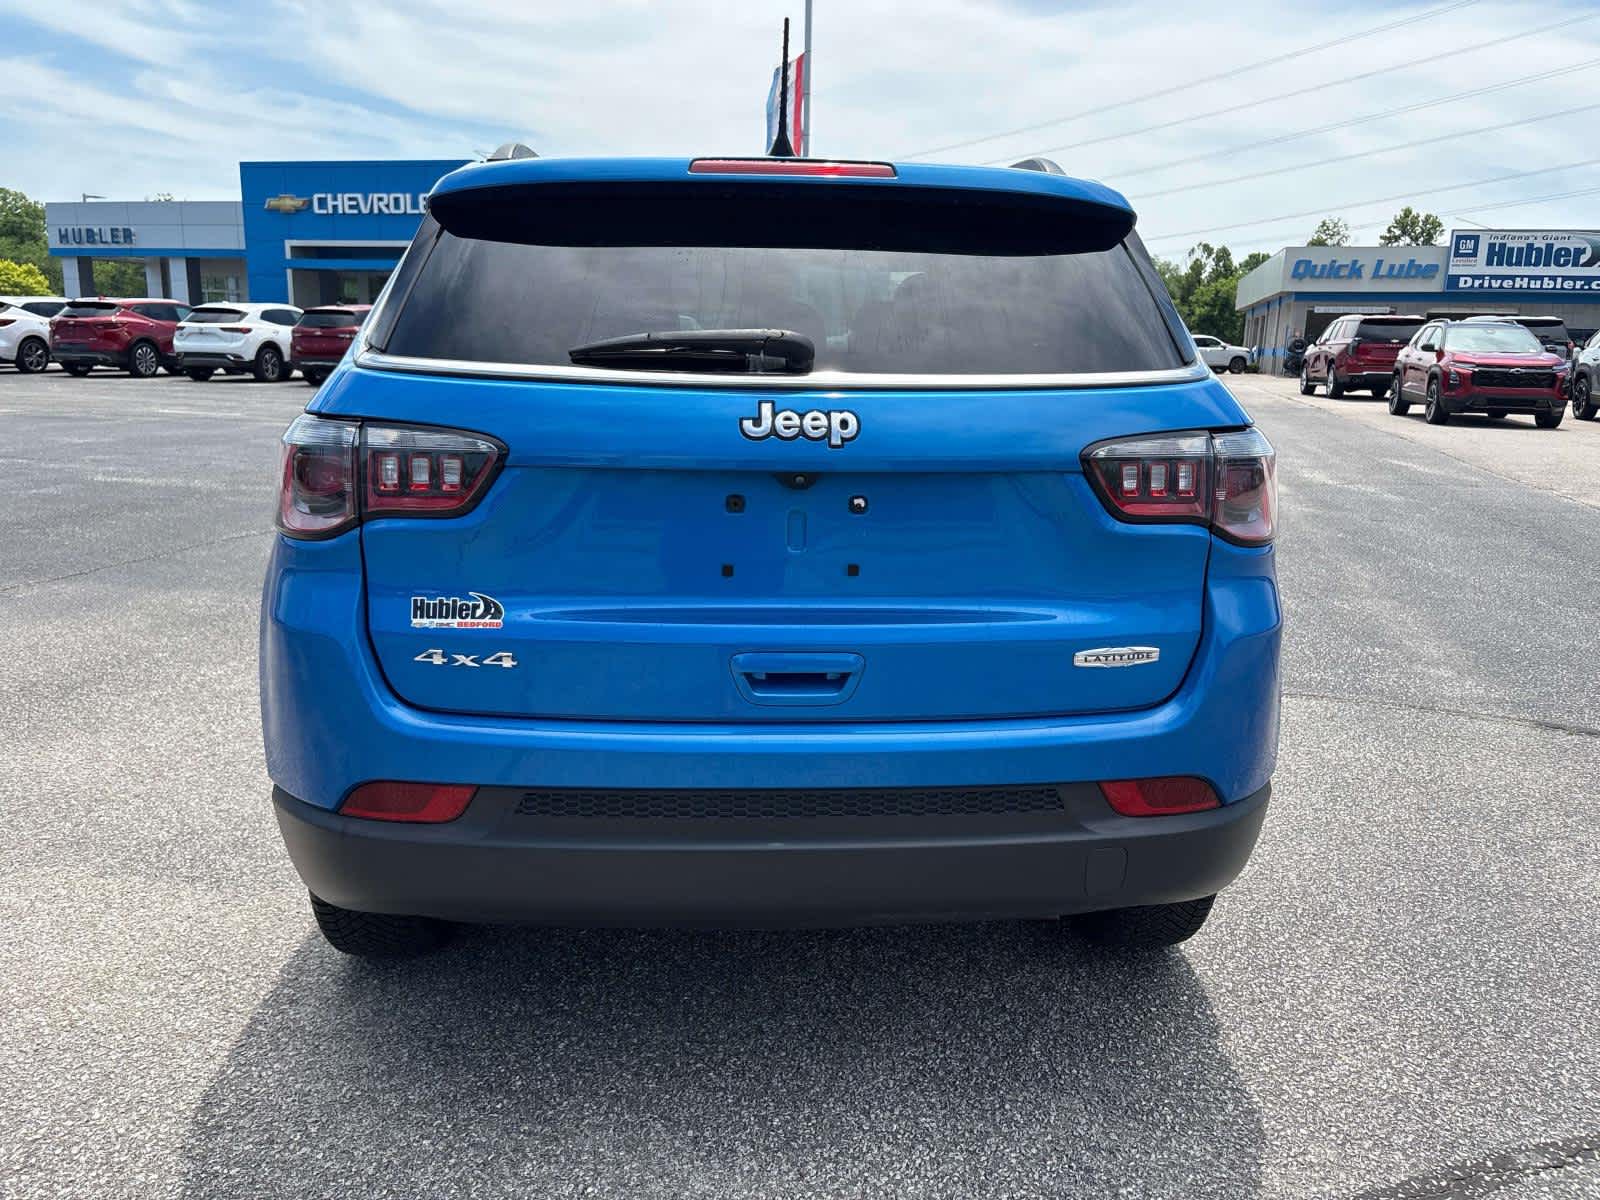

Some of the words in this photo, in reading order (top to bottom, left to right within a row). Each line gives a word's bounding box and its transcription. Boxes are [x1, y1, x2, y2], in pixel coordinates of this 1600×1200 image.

[58, 227, 134, 244] HUBLER
[1460, 239, 1475, 250] GM
[1485, 242, 1587, 267] Hubler
[1291, 259, 1365, 281] Quick
[1371, 258, 1440, 279] Lube
[740, 400, 860, 448] Jeep
[411, 597, 482, 620] Hubler
[413, 649, 518, 668] 4x4
[1084, 651, 1154, 663] LATITUDE
